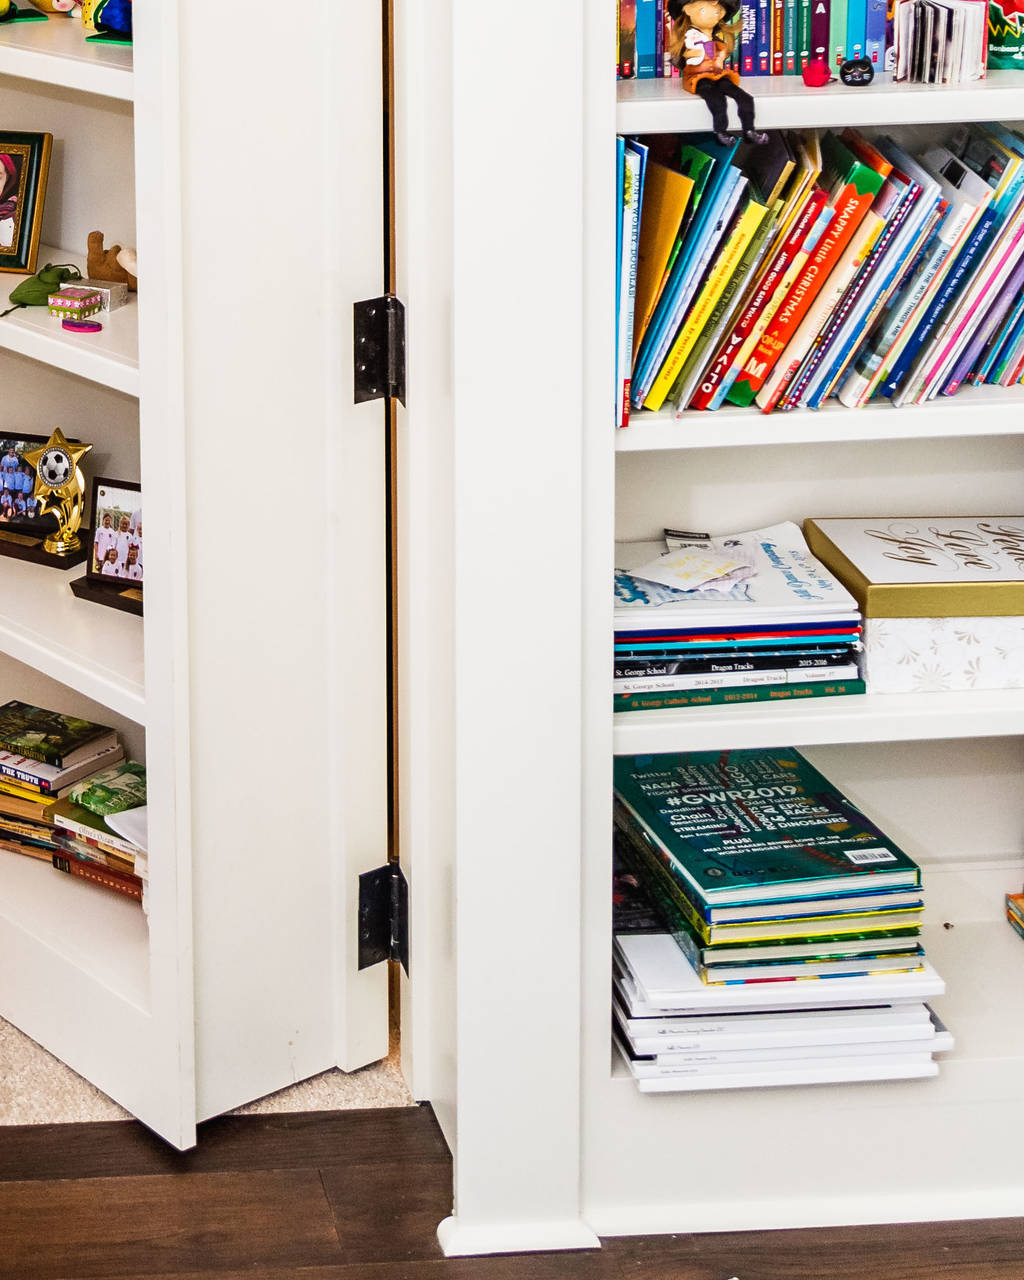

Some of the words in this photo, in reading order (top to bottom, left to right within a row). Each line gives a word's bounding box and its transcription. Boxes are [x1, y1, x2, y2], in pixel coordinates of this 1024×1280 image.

[741, 4, 749, 43] INVINCIBLE
[830, 197, 858, 238] SNAPPY
[815, 238, 834, 263] Little
[931, 247, 946, 270] WHERE
[923, 271, 932, 283] THE
[741, 306, 756, 327] OLIVIA
[753, 291, 765, 306] SAYS
[762, 271, 776, 290] GOOD
[773, 251, 788, 271] NIGHT
[779, 264, 818, 323] CHRISTMAS
[913, 284, 924, 300] WILD
[899, 300, 915, 324] THINGS
[891, 324, 900, 336] ARE
[701, 333, 742, 393] OLIVIA
[624, 668, 646, 677] George
[647, 666, 667, 675] School
[711, 664, 733, 672] Dragon
[799, 659, 828, 667] 2015-2016
[1, 766, 15, 775] THE
[16, 771, 39, 783] TRUTH
[725, 765, 752, 786] LEGO
[666, 785, 797, 806] #GWR2019
[669, 812, 712, 820] Chain
[750, 807, 776, 829] ROBOTS
[784, 806, 830, 815] RACES
[673, 823, 728, 831] STREAMING
[777, 817, 848, 827] DINOSAURS
